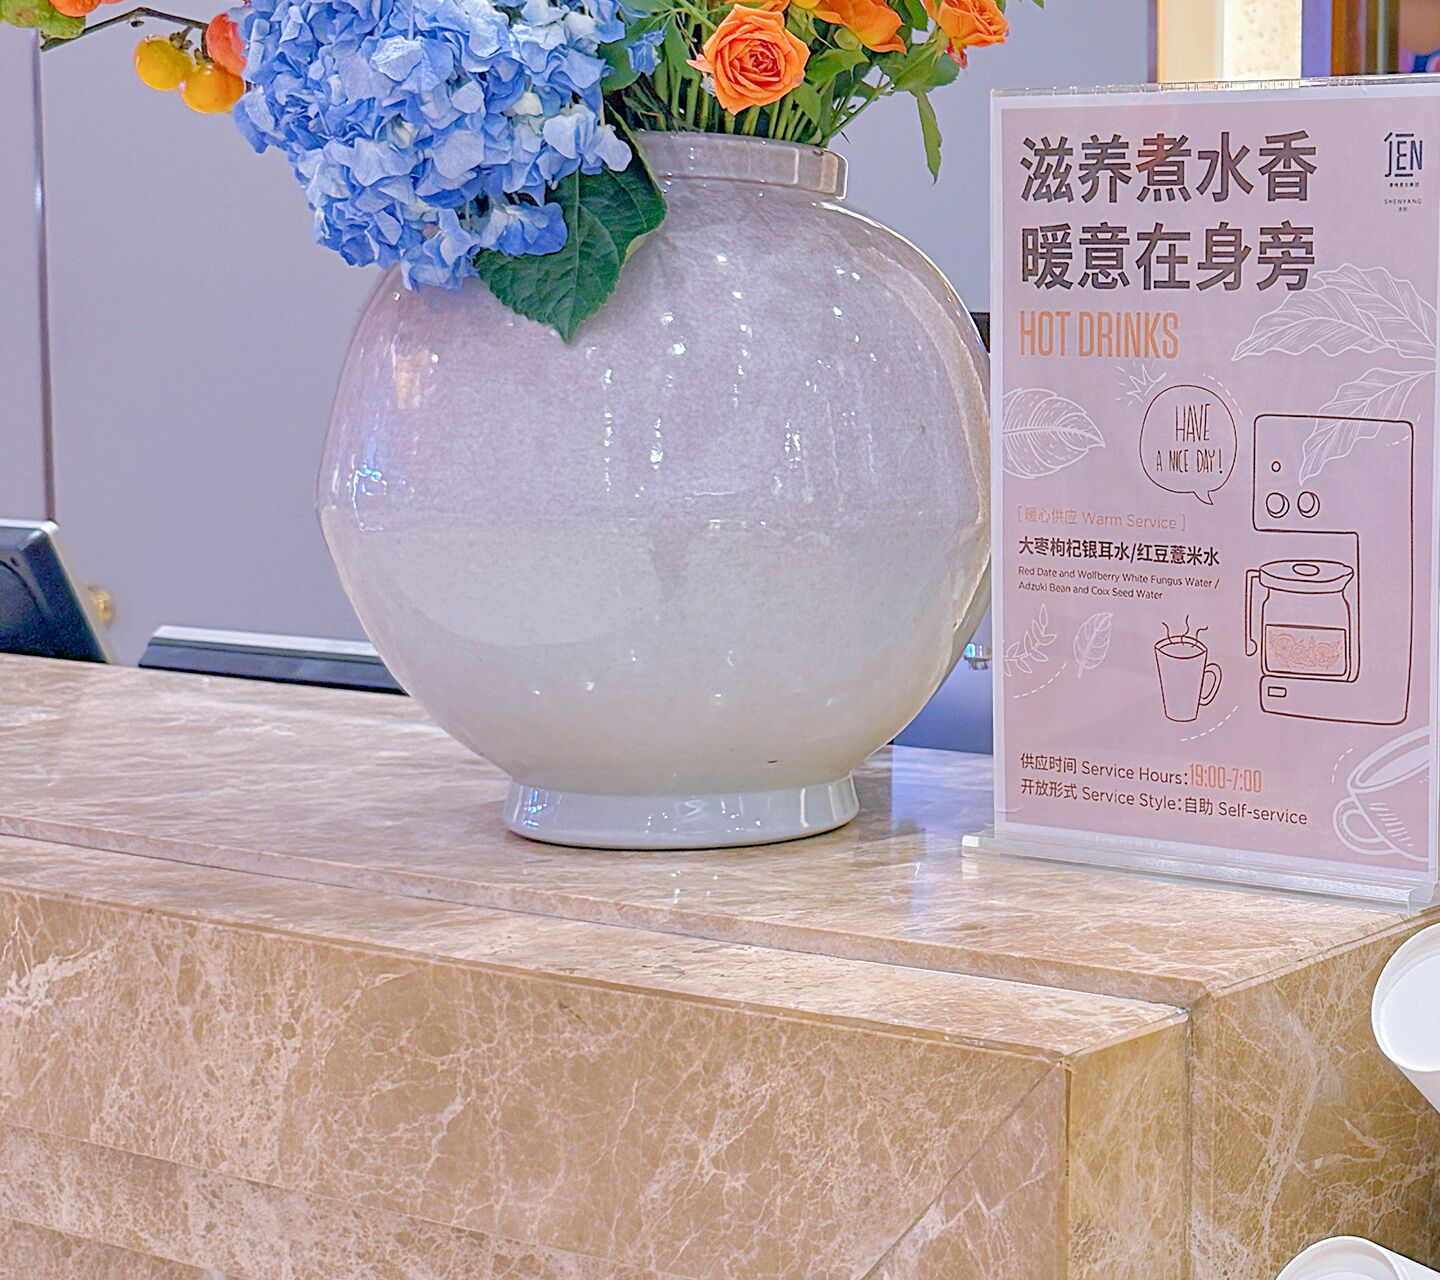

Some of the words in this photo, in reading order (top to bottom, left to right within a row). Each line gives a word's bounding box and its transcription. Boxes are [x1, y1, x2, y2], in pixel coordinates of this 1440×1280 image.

[1020, 131, 1318, 204] 滋养煮水香
[1384, 132, 1423, 177] JEN
[1021, 221, 1316, 293] 暖意在身旁
[1020, 310, 1071, 356] HOT
[1079, 312, 1179, 359] DRINKS
[1175, 404, 1211, 442] HAVE
[1156, 449, 1163, 472] A
[1168, 449, 1189, 473] NICE
[1082, 511, 1122, 528] Warm
[1126, 513, 1178, 530] Service
[1018, 566, 1035, 576] Red
[1037, 567, 1058, 578] Date
[1059, 568, 1077, 579] and
[1078, 570, 1121, 583] Wolfberry
[1122, 573, 1149, 584] White
[1150, 575, 1183, 587] Fungus
[1185, 577, 1213, 588] Water
[1018, 581, 1048, 592] Adzuki
[1050, 582, 1072, 594] Bean
[1073, 584, 1090, 595] and
[1091, 586, 1110, 596] Coix
[1112, 587, 1134, 598] Seed
[1136, 589, 1164, 600] Water
[1020, 752, 1077, 775] 供应时间
[1081, 760, 1135, 780] Service
[1021, 778, 1078, 801] 开放形式
[1082, 786, 1135, 806] Service
[1218, 801, 1308, 825] Self-service
